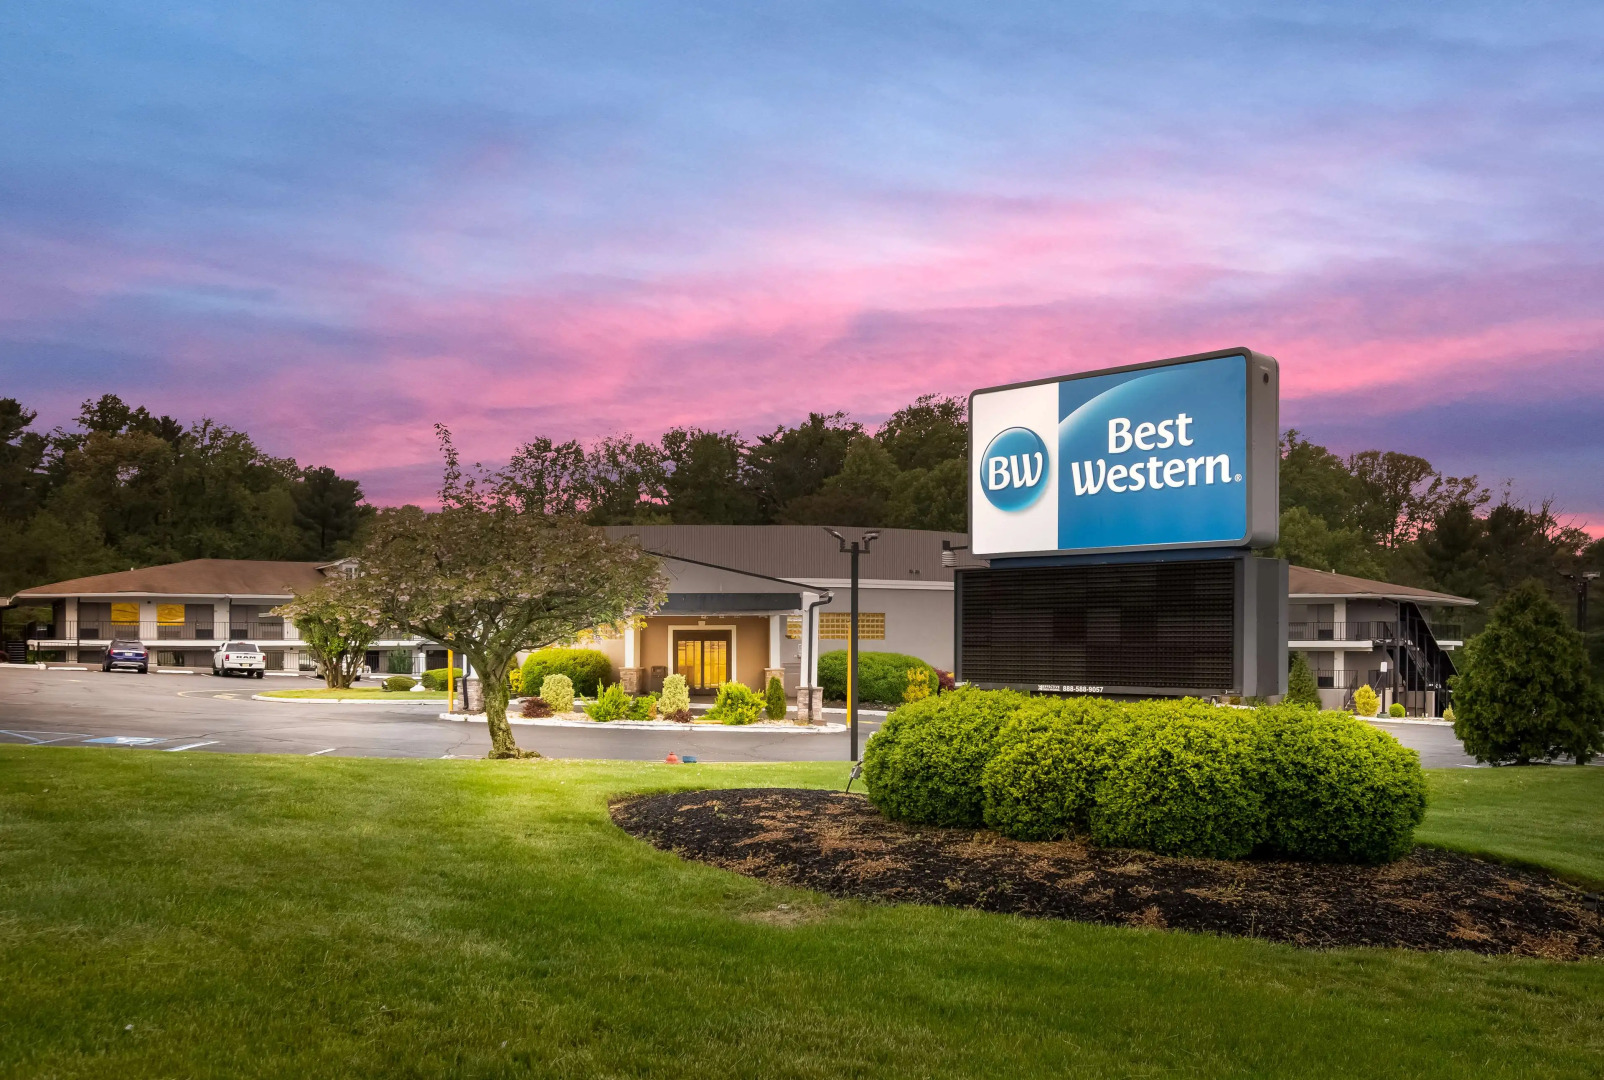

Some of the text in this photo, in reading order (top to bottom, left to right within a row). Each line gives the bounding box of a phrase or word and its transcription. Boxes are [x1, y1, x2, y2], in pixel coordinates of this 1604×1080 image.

[1108, 413, 1193, 454] Best
[988, 452, 1043, 491] BW
[1062, 685, 1104, 693] 888-588-9057
